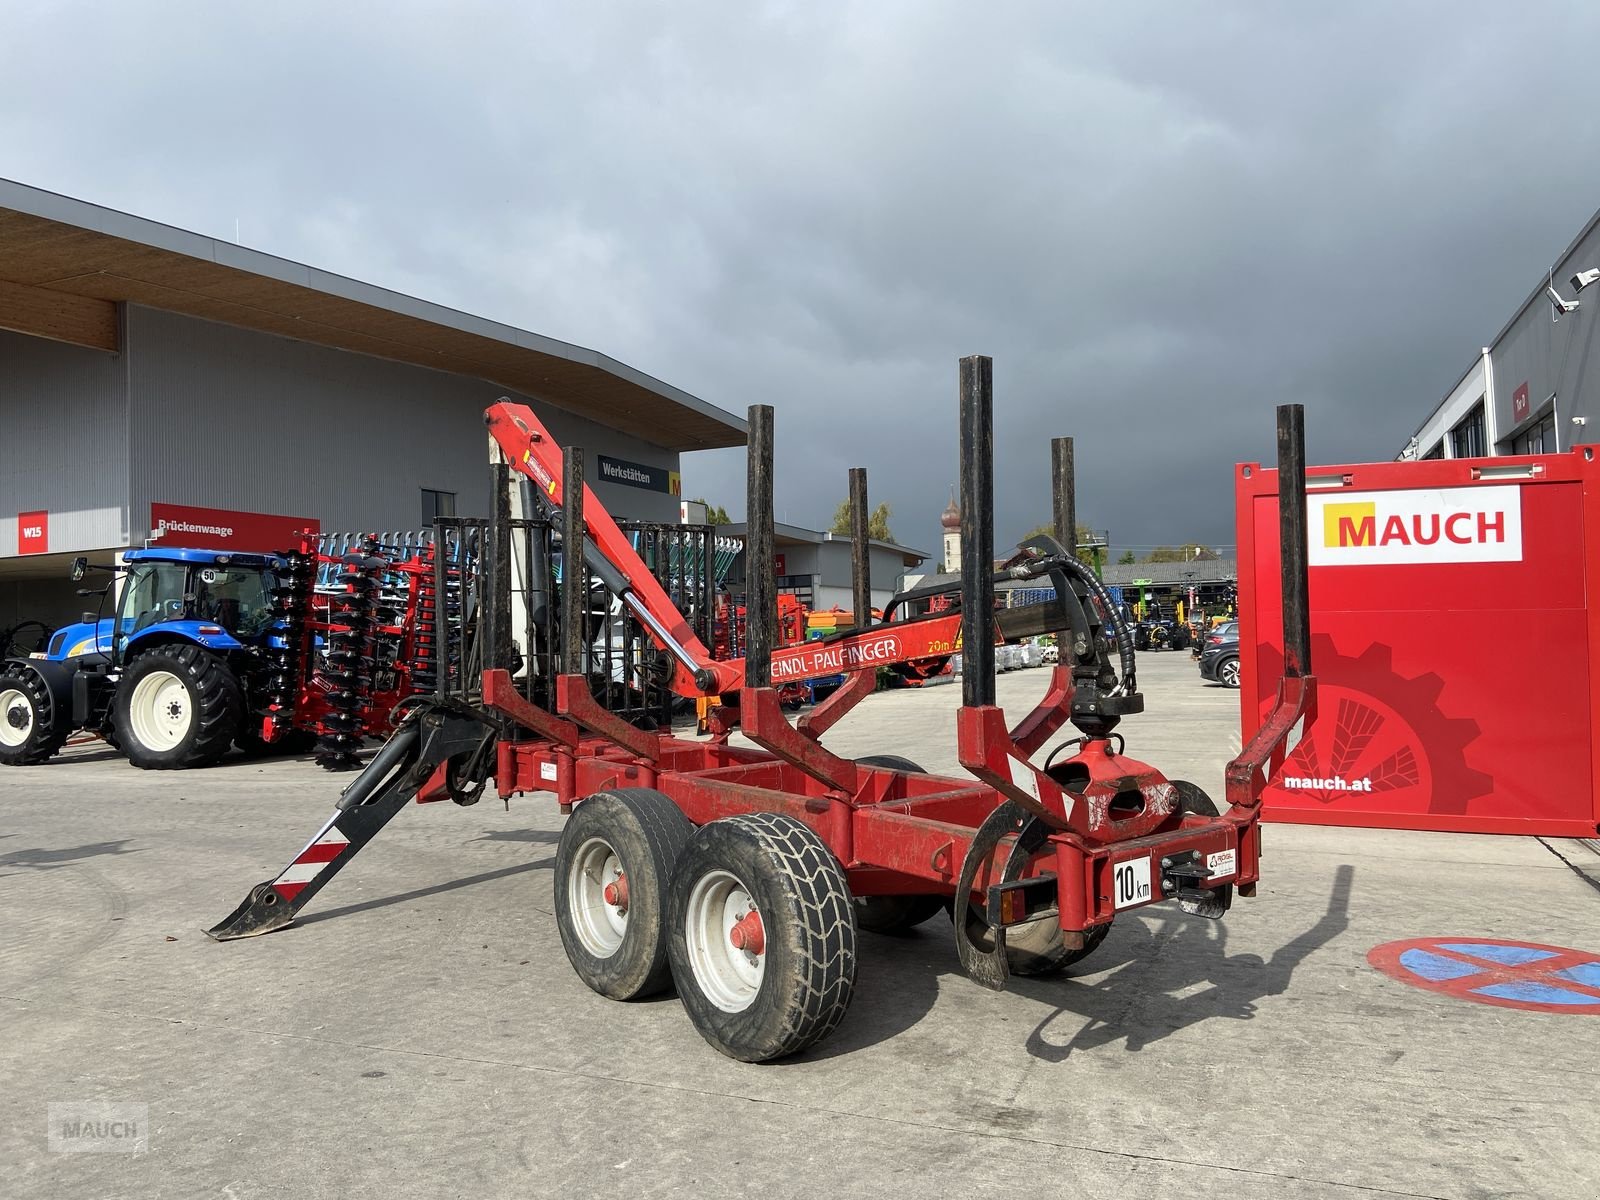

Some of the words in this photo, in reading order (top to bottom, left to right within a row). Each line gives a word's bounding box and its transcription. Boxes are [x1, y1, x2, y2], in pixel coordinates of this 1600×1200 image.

[602, 462, 650, 484] Werkstätten
[23, 526, 42, 538] W15
[158, 519, 233, 537] Brückenwaage
[1339, 511, 1505, 547] MAUCH
[204, 570, 215, 581] 50
[928, 640, 950, 653] 20m
[771, 639, 897, 677] EINDL-PALFINGER
[1284, 775, 1372, 791] mauch.at
[1116, 865, 1134, 903] 10
[1137, 880, 1149, 898] km
